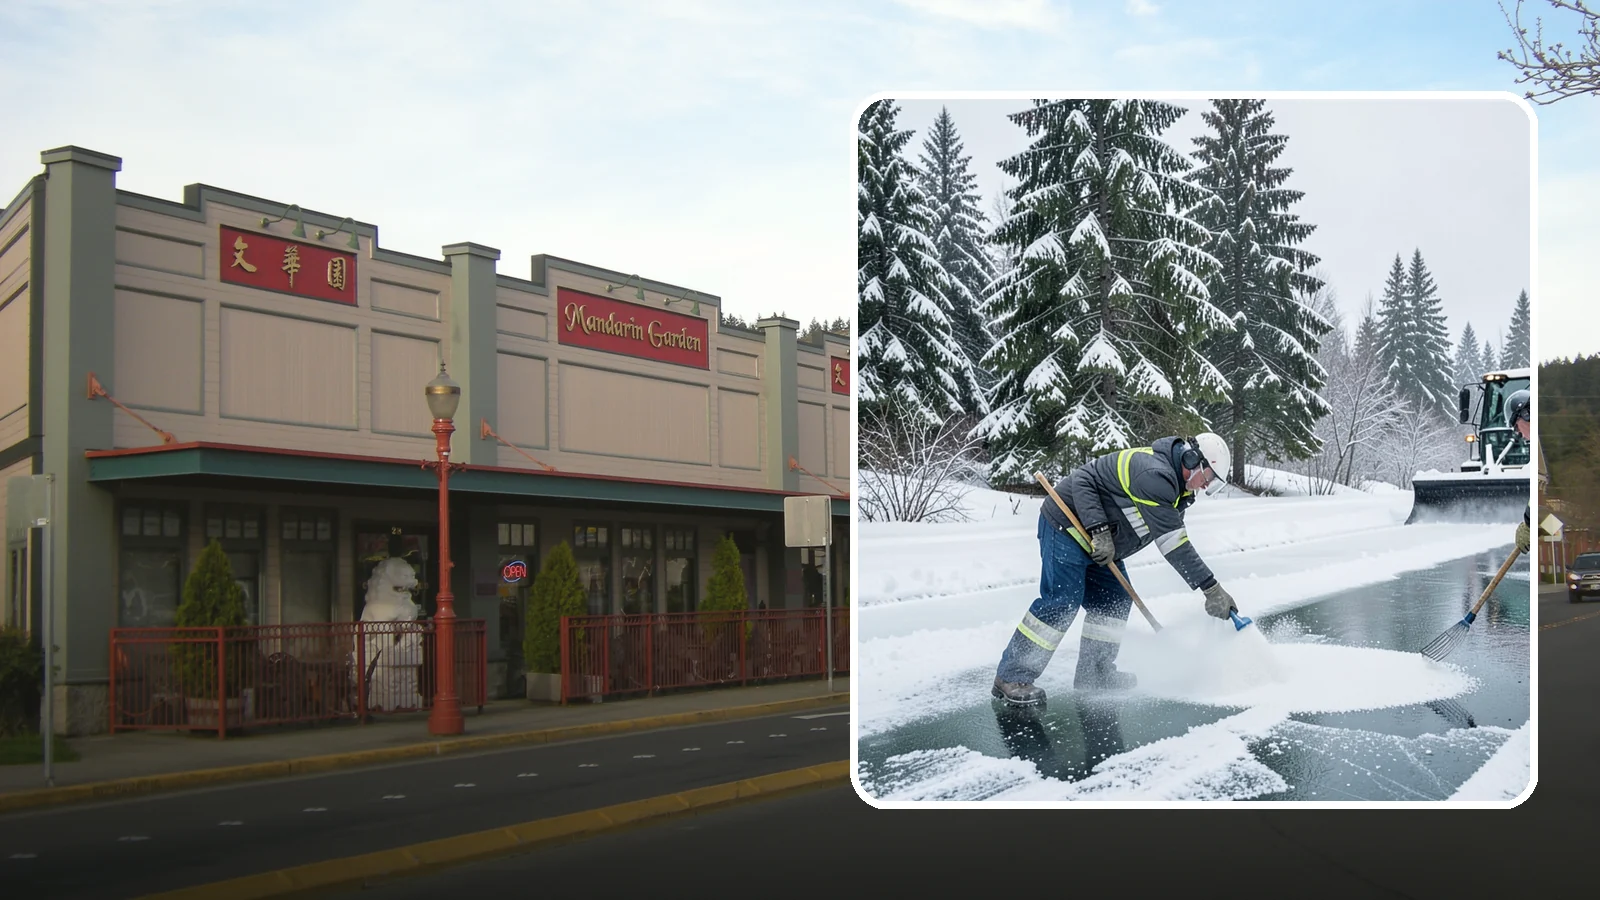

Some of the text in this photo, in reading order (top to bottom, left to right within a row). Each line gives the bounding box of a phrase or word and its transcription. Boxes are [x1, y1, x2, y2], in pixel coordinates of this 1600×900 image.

[231, 236, 346, 291] 文華園
[564, 302, 701, 352] Mandarin Garden
[503, 565, 527, 578] OPEN
